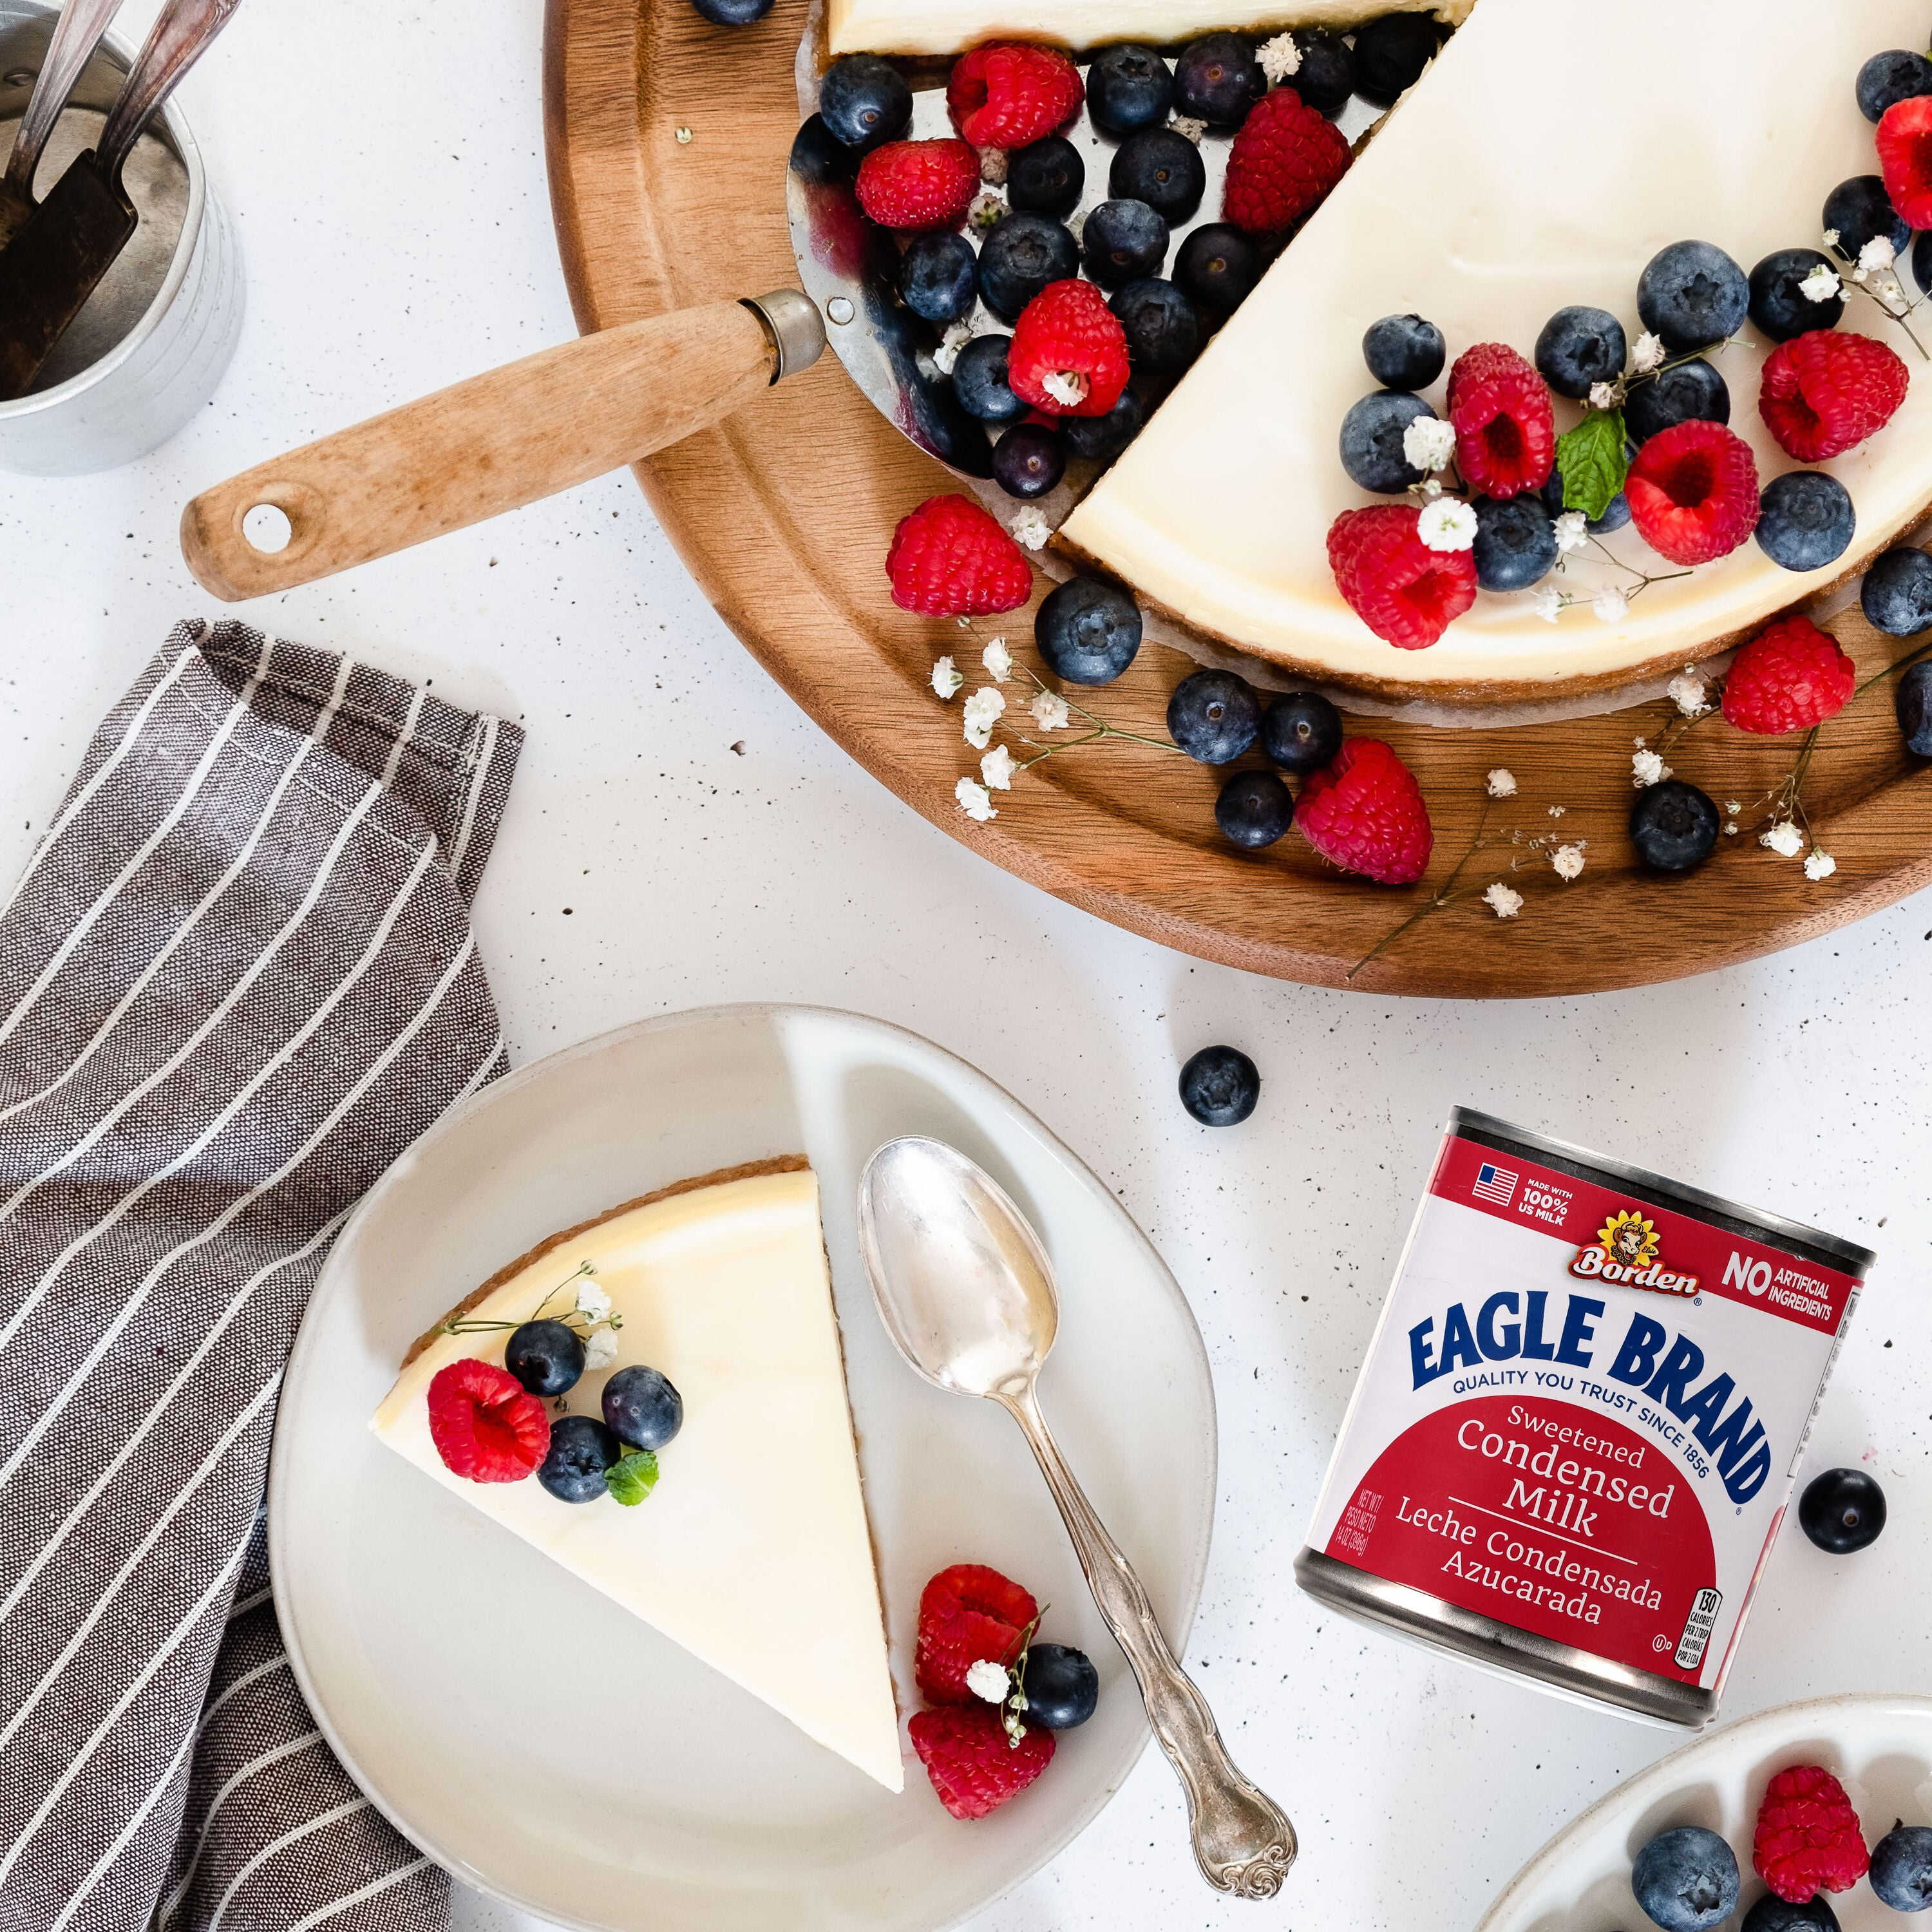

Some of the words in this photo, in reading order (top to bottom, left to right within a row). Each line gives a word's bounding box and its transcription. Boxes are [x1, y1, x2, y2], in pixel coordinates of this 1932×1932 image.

[1523, 1188, 1569, 1215] 100%
[1528, 1179, 1549, 1191] MADE
[1551, 1187, 1573, 1199] WITH
[1519, 1202, 1535, 1215] US
[1535, 1208, 1566, 1226] MILK
[1642, 1245, 1656, 1254] Elsie
[1573, 1246, 1696, 1294] Borden
[1721, 1251, 1772, 1296] NO
[1774, 1267, 1830, 1300] ARTIFICIAL
[1768, 1285, 1833, 1321] INGREDIENTS
[1408, 1291, 1605, 1392] EAGLE
[1606, 1311, 1771, 1504] BRAND
[1454, 1370, 1528, 1394] QUALITY
[1535, 1372, 1573, 1390] YOU
[1580, 1380, 1637, 1412] TRUST
[1638, 1407, 1685, 1448] SINCE
[1683, 1444, 1709, 1479] 1856
[1507, 1405, 1645, 1468] Sweetened
[1457, 1419, 1675, 1518] Condensed
[1344, 1506, 1361, 1528] PESO
[1358, 1511, 1376, 1533] NETO
[1502, 1478, 1598, 1537] Milk
[1335, 1525, 1345, 1543] 14
[1341, 1527, 1352, 1546] OZ
[1347, 1530, 1369, 1557] (396g)
[1396, 1495, 1477, 1545] Leche
[1486, 1531, 1663, 1610] Condensada
[1440, 1550, 1602, 1625] Azucarada
[1698, 1591, 1717, 1613] 130
[1685, 1624, 1694, 1635] PER
[1694, 1627, 1699, 1636] 2
[1698, 1628, 1709, 1640] TBSP
[1690, 1611, 1713, 1627] CALORIES
[1677, 1650, 1689, 1662] POR
[1687, 1653, 1691, 1663] 2
[1690, 1654, 1699, 1665] CDA
[1682, 1638, 1703, 1652] CALORÍAS
